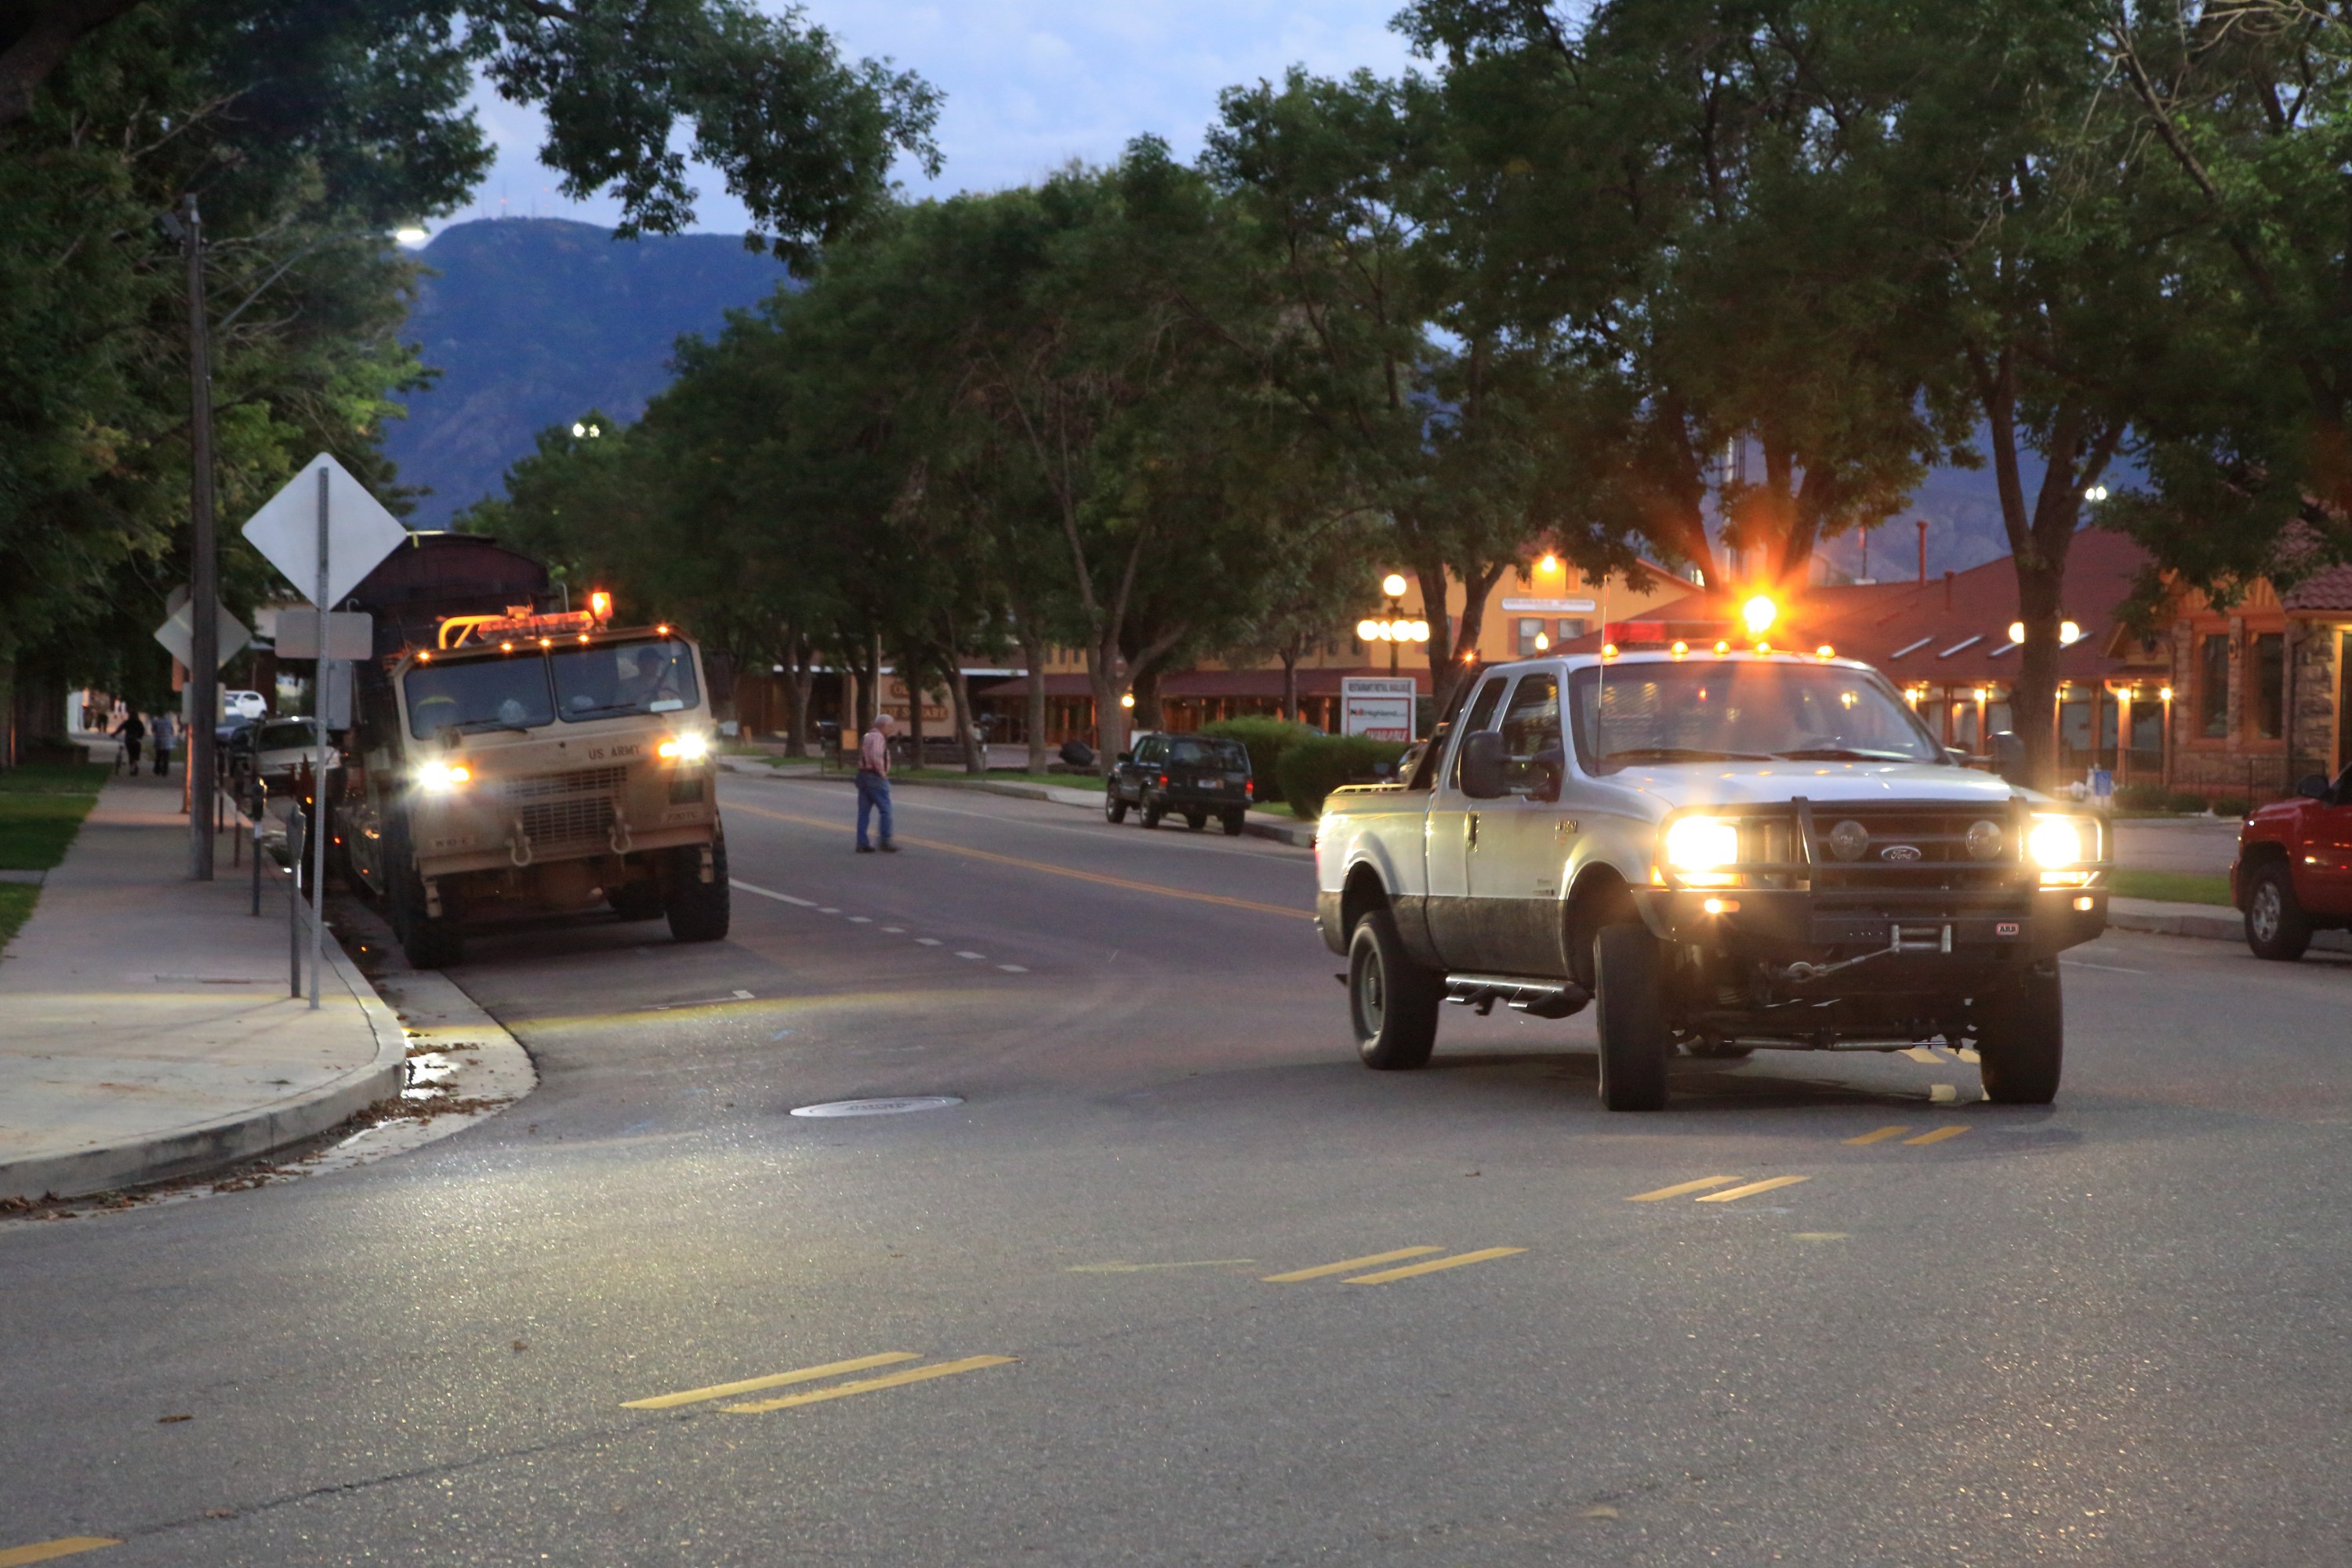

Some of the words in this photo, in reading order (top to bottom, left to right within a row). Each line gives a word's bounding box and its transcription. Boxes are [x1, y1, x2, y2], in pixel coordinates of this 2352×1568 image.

[589, 749, 604, 760] US
[612, 744, 639, 757] ARMY
[1890, 848, 1913, 860] Ford
